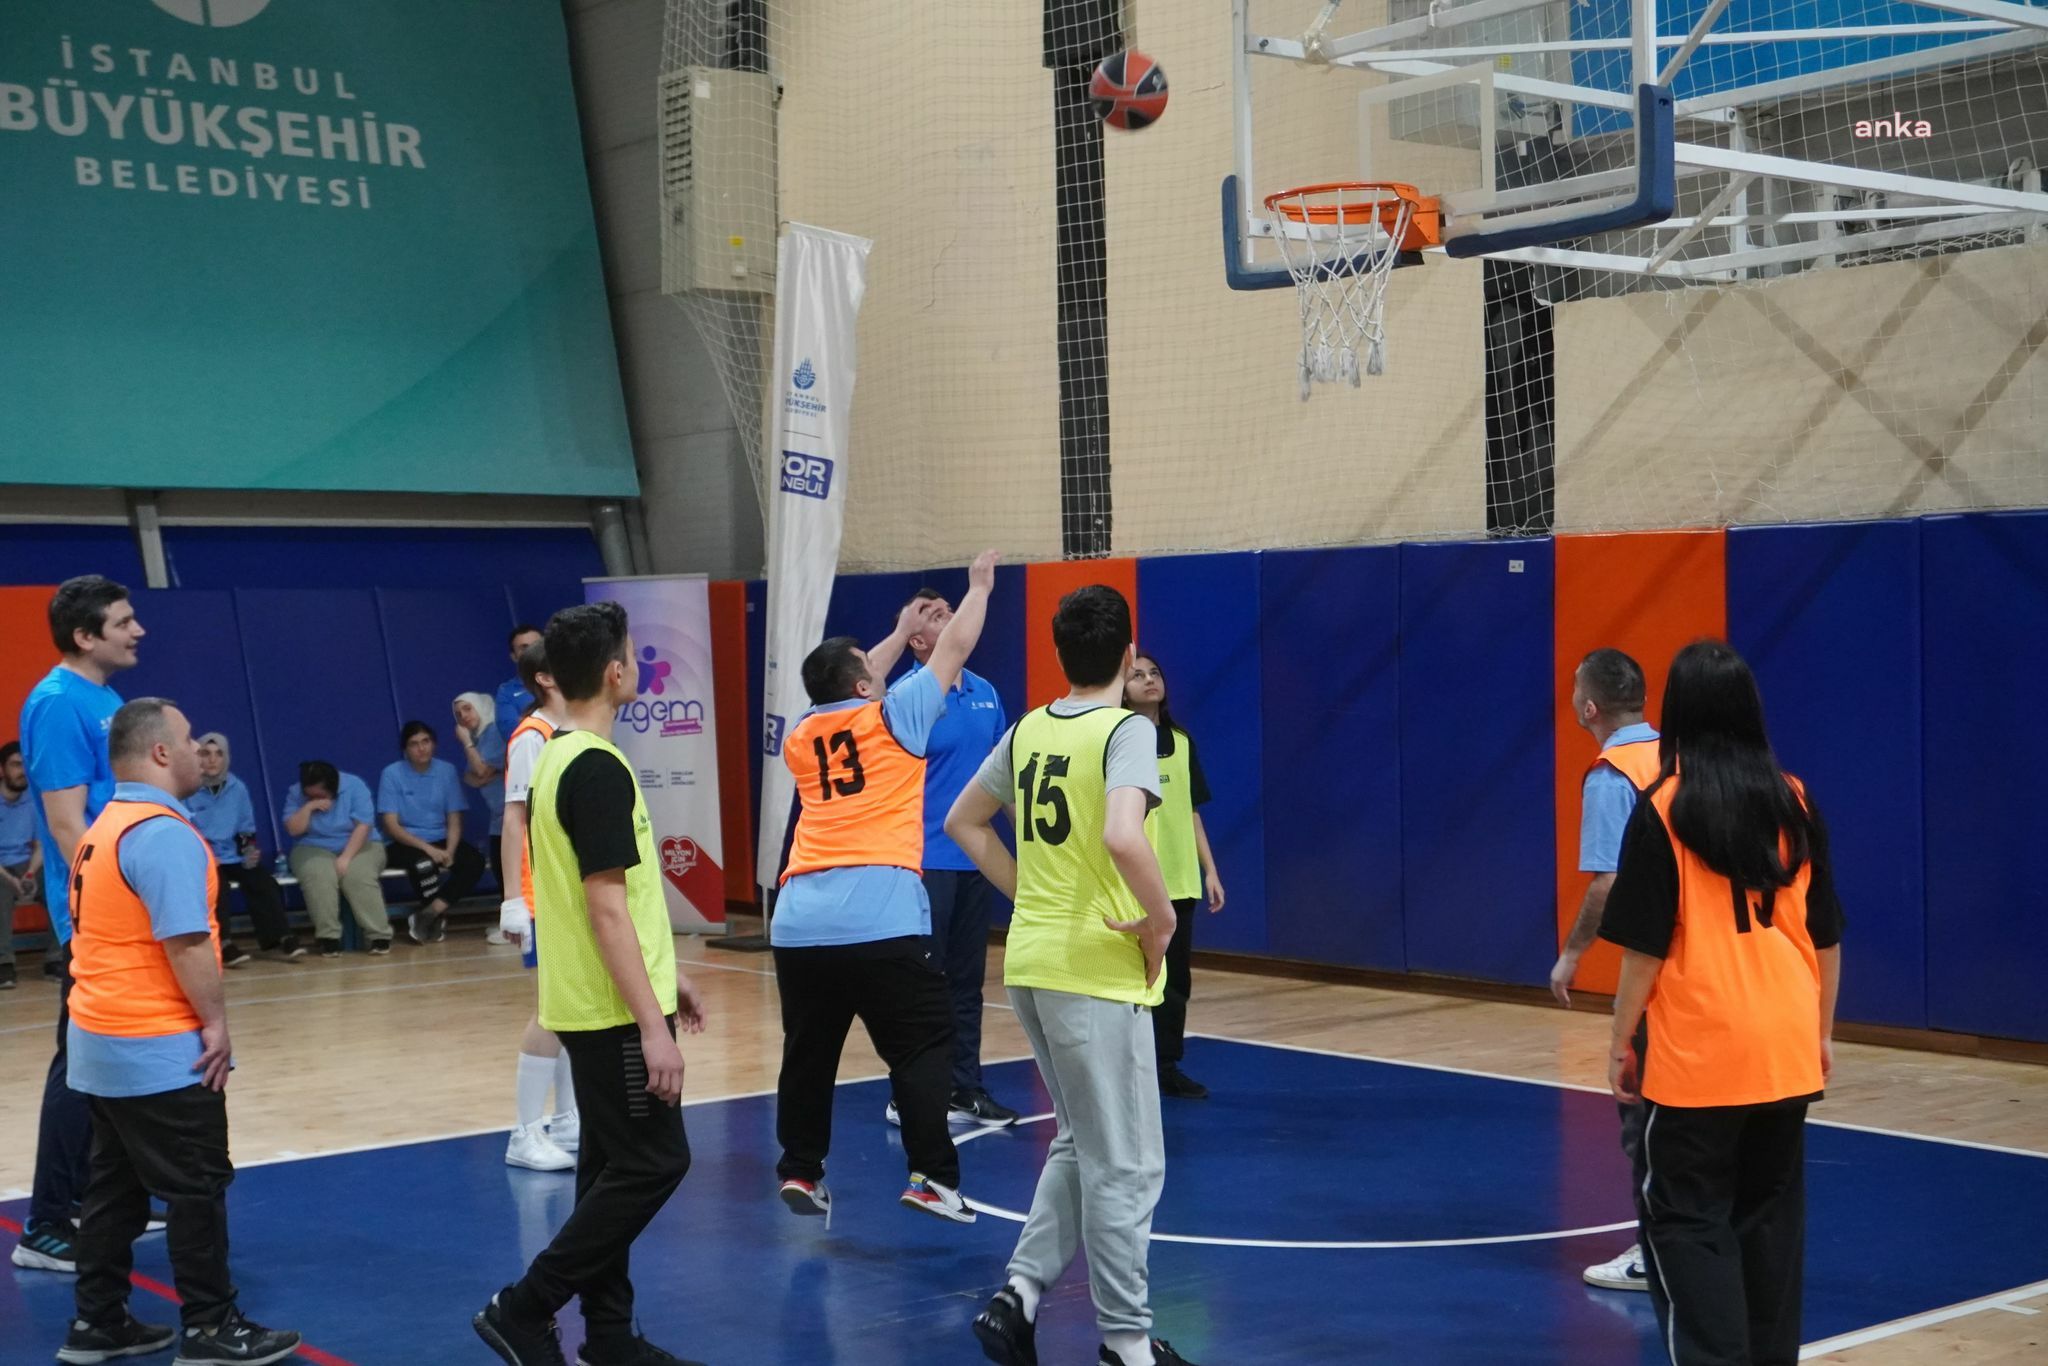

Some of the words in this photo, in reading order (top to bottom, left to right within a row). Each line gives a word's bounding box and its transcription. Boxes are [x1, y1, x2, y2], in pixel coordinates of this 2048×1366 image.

[61, 35, 356, 100] İSTANBUL
[0, 78, 426, 169] BÜYÜKŞEHİR
[75, 156, 371, 209] BELEDİYESİ
[615, 700, 704, 733] zgem
[813, 729, 866, 802] 13
[1018, 751, 1071, 846] 15
